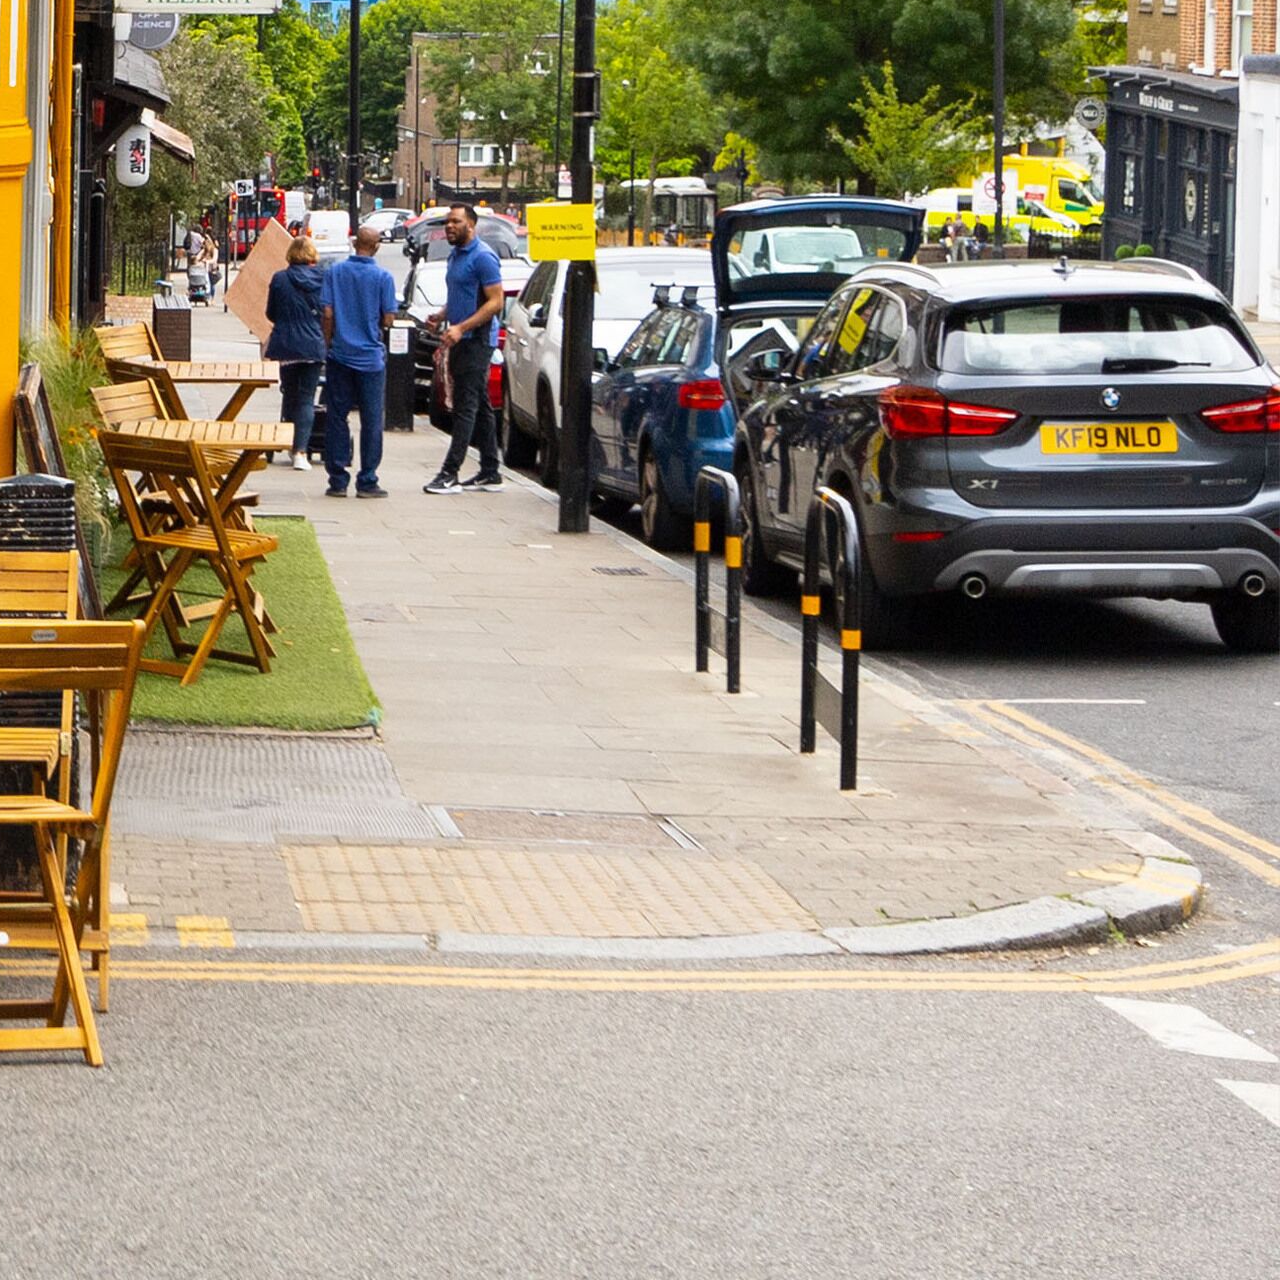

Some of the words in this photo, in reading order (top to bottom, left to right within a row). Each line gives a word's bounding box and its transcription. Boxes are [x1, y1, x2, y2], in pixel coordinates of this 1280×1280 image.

[133, 20, 172, 28] ICENCE
[541, 223, 584, 231] WARNING
[1055, 427, 1108, 448] KF19
[1115, 426, 1161, 448] NLO
[967, 479, 998, 490] X1
